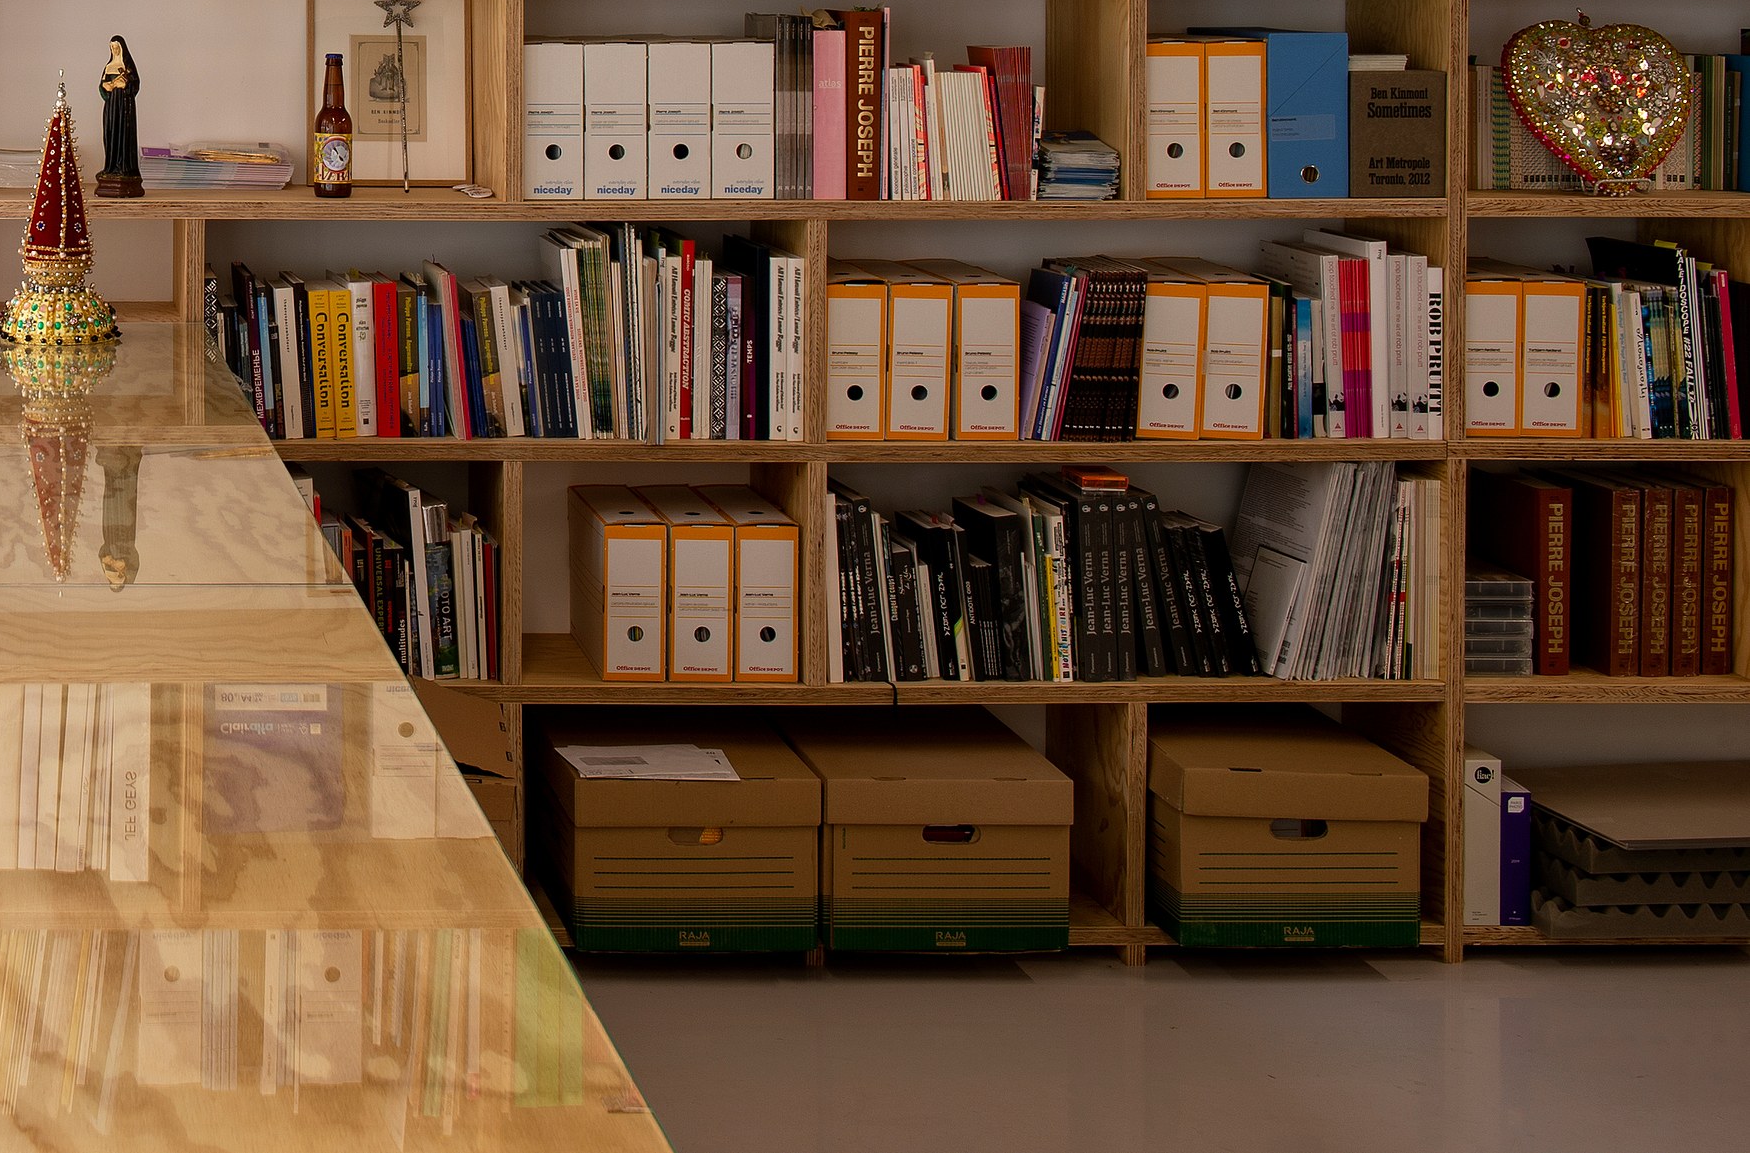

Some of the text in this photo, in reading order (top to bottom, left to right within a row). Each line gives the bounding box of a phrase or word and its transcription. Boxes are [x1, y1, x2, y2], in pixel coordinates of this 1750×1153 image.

[818, 78, 842, 88] atlas
[857, 26, 875, 177] PIERRE JOSEPH
[1367, 102, 1432, 119] Sometimes
[1371, 88, 1428, 100] Ben Kinmont
[597, 185, 636, 195] niceday
[724, 185, 763, 194] niceday
[1368, 156, 1430, 171] Art Metropole
[1368, 172, 1430, 186] Toronto, 2012
[683, 288, 691, 320] COMIC
[1676, 249, 1690, 334] KALEIDOSCOPE
[252, 349, 265, 420] МЕЖВРЕМЕНЬЕ
[314, 311, 330, 410] Conversation
[336, 311, 353, 410] Conversation
[1429, 292, 1442, 417] ROB PRUITT
[863, 551, 880, 634] Jean-Luc Verna
[1084, 551, 1097, 635] Jean-Luc Verna
[1100, 550, 1114, 634] Jean-Luc Verna
[1118, 551, 1131, 634] Jean-Luc Verna
[1548, 503, 1564, 653] PIERRE JOSEPH
[1619, 505, 1636, 653] PIERRE JOSEPH
[1651, 504, 1668, 654] PIERRE JOSEPH
[442, 616, 453, 640] ART
[679, 931, 710, 940] RAJA
[935, 931, 967, 940] RAJA
[1283, 926, 1315, 936] RAJA
